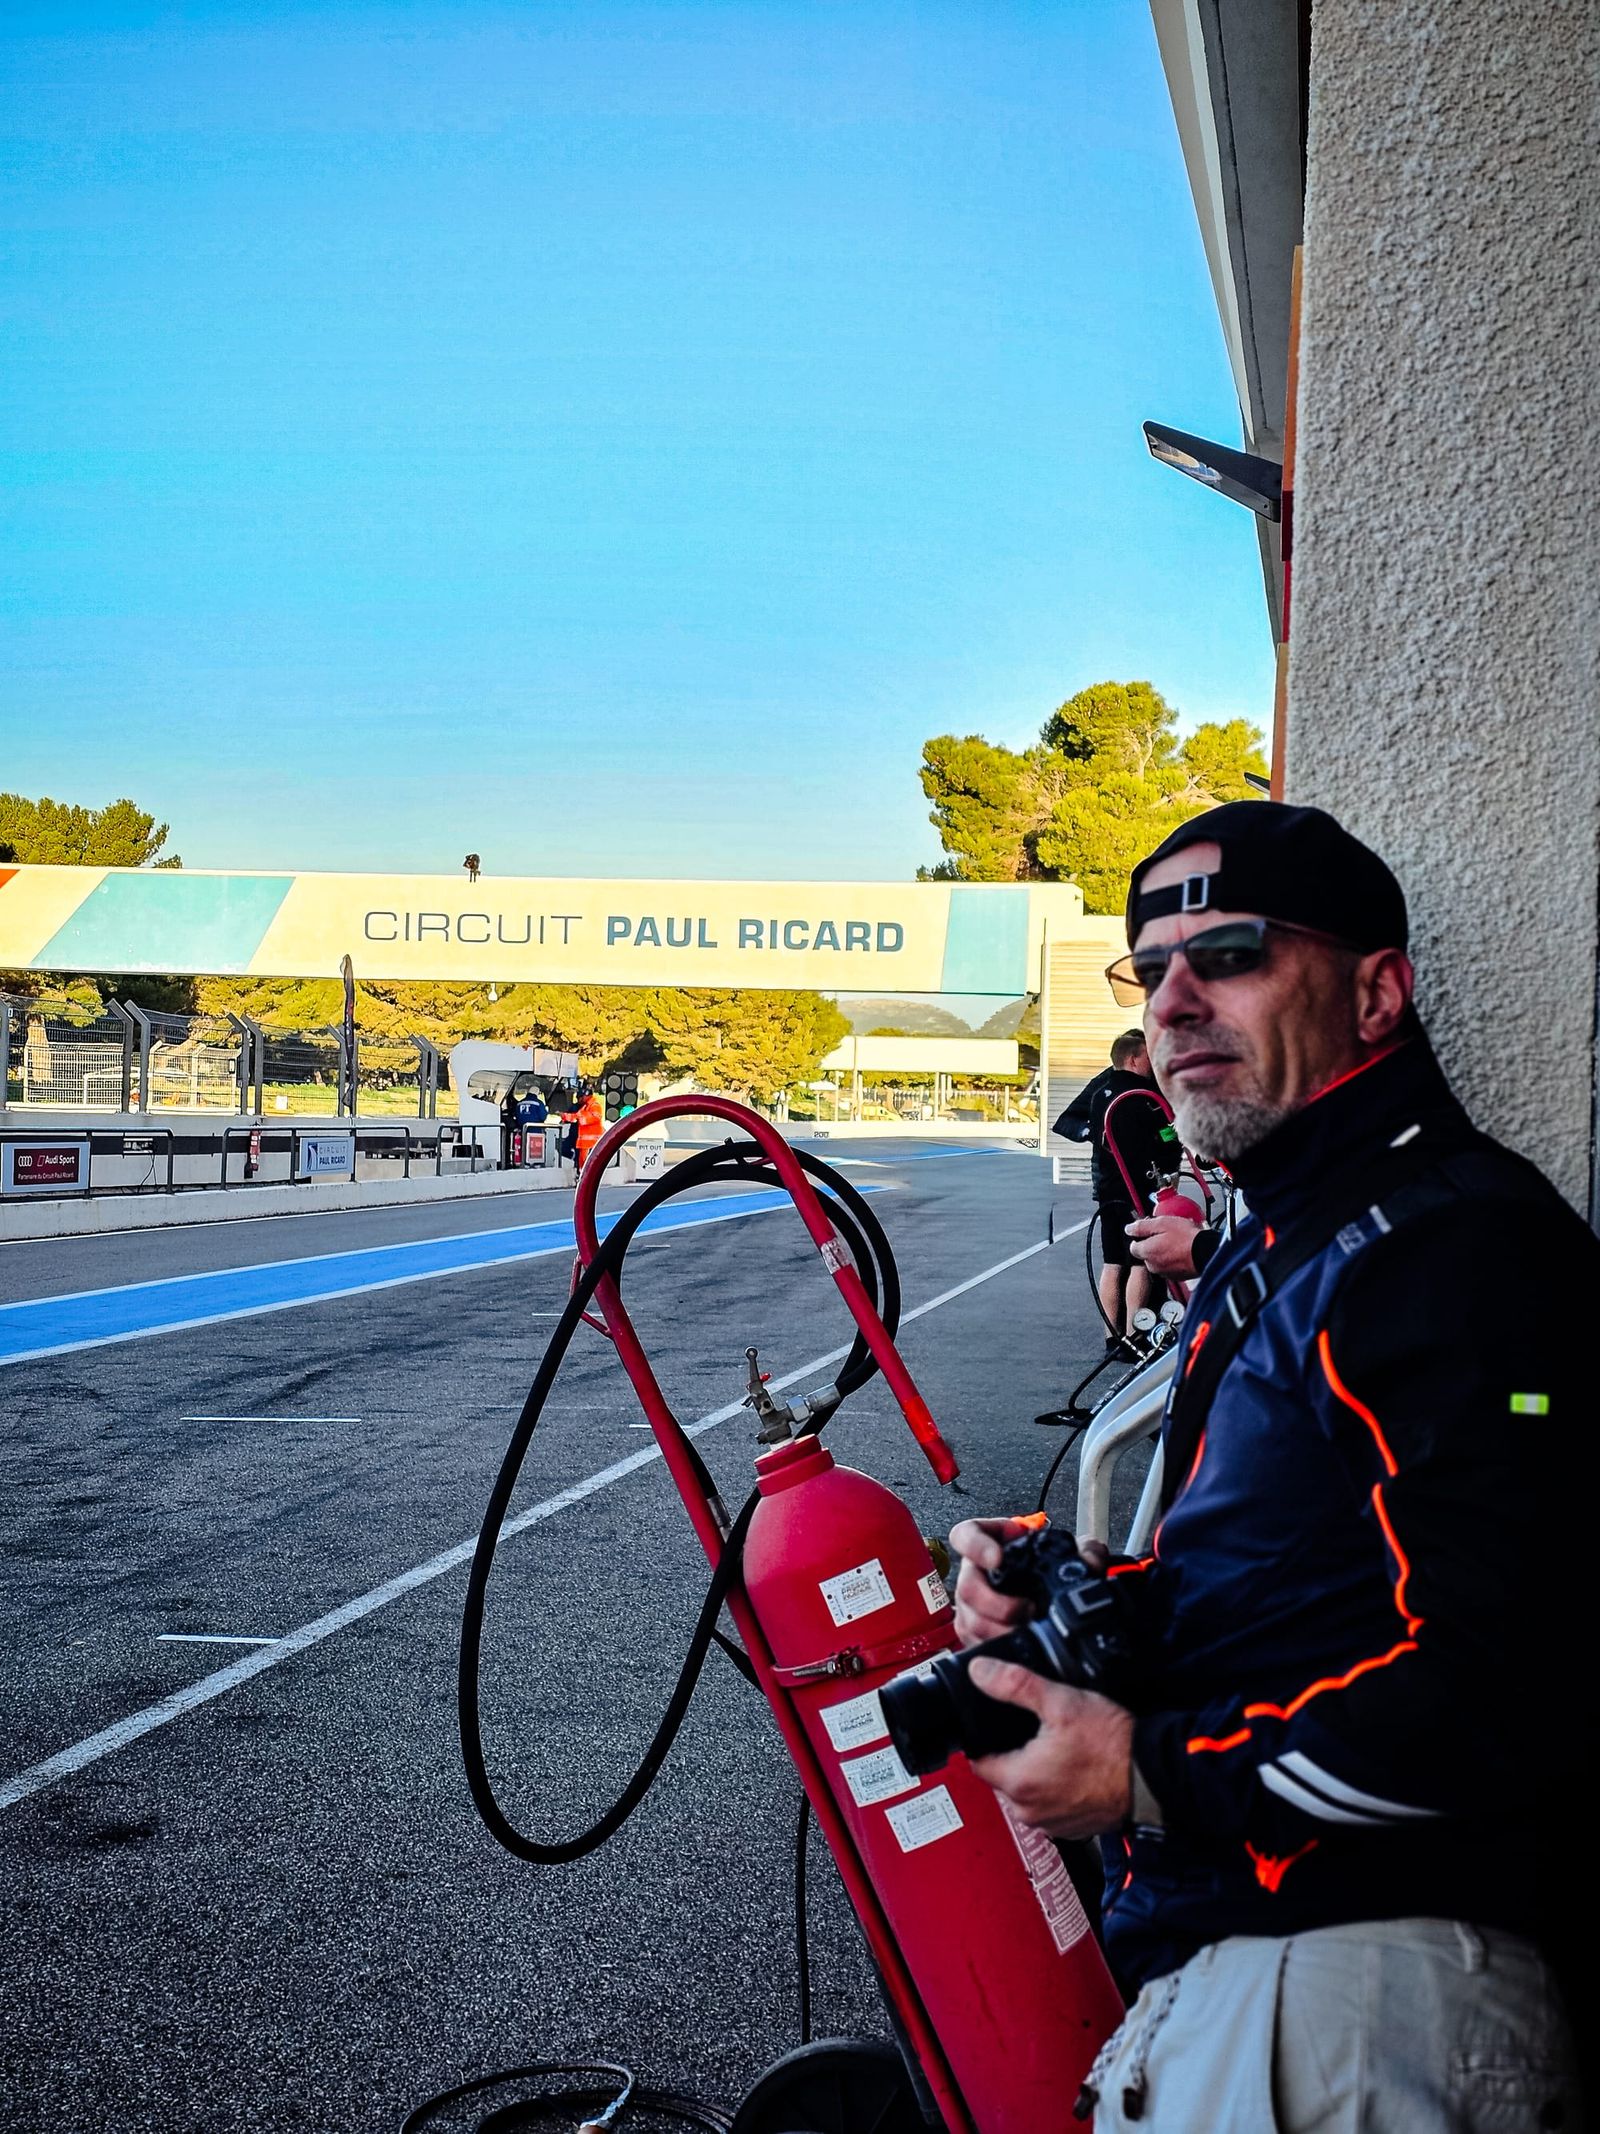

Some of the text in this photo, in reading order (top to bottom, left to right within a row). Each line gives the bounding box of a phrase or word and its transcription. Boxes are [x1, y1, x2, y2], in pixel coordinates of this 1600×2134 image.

[364, 911, 904, 952] CIRCUIT PAUL RICARD
[45, 1154, 75, 1166] Audi Sport
[330, 1156, 346, 1164] RICARD
[644, 1156, 656, 1166] 50
